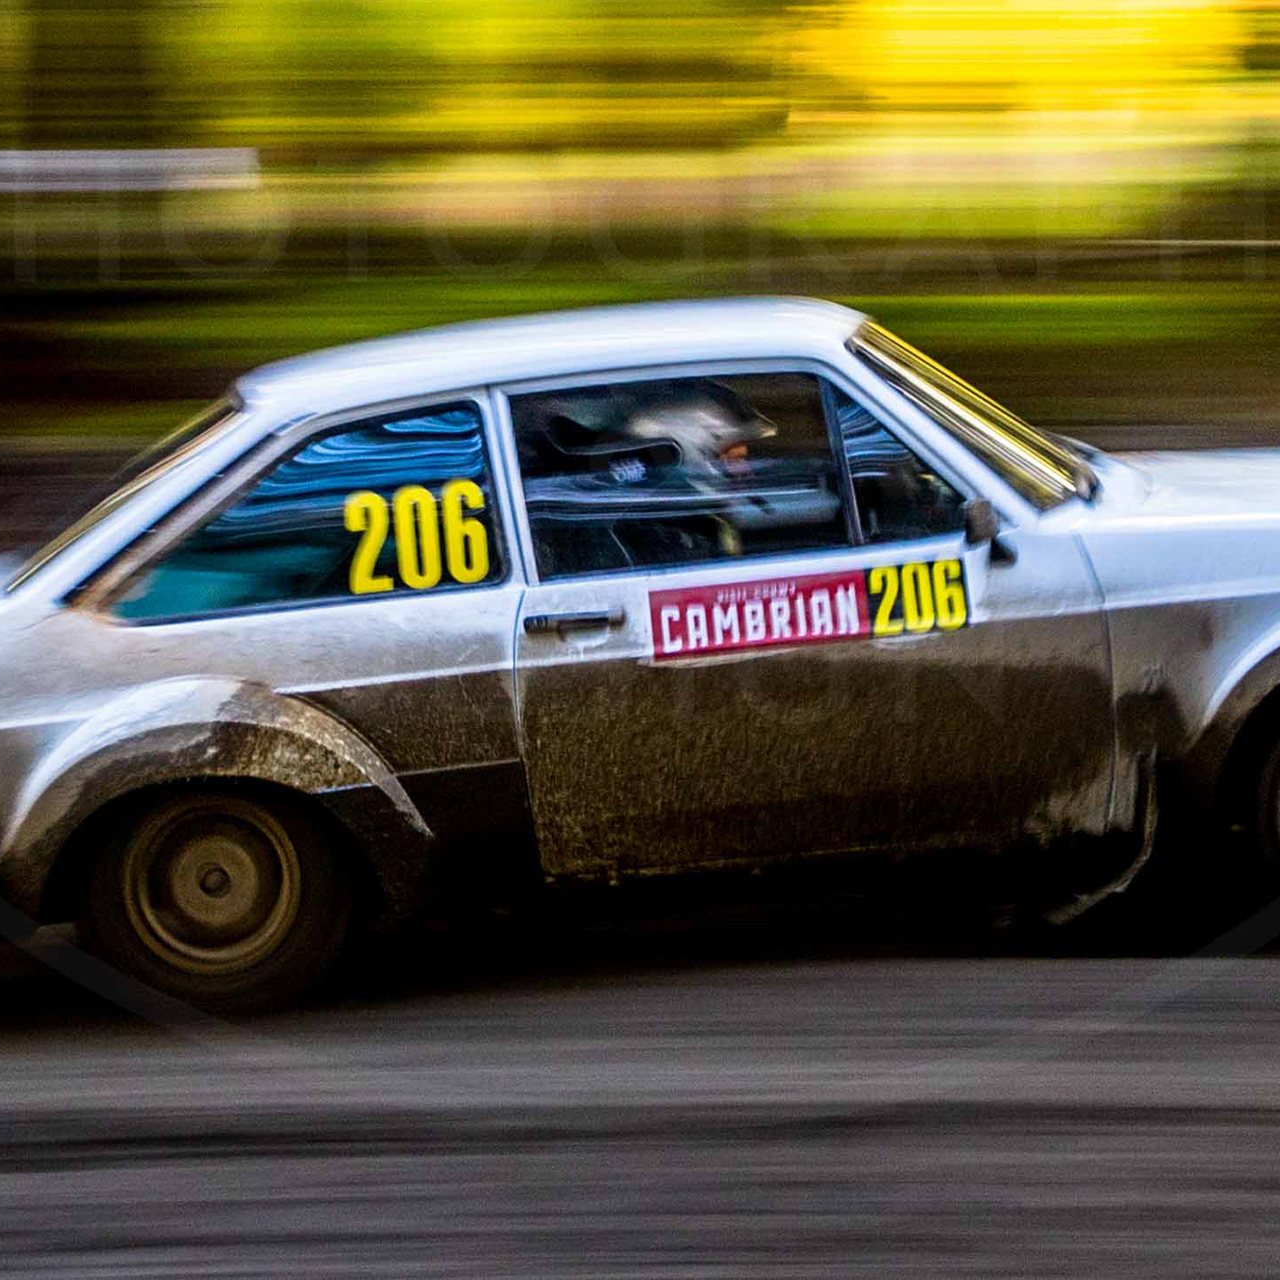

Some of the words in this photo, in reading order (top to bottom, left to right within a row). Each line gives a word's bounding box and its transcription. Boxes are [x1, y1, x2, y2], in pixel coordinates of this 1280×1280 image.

[345, 479, 488, 594] 206
[660, 583, 860, 654] CAMBRIAN
[870, 559, 968, 636] 206
